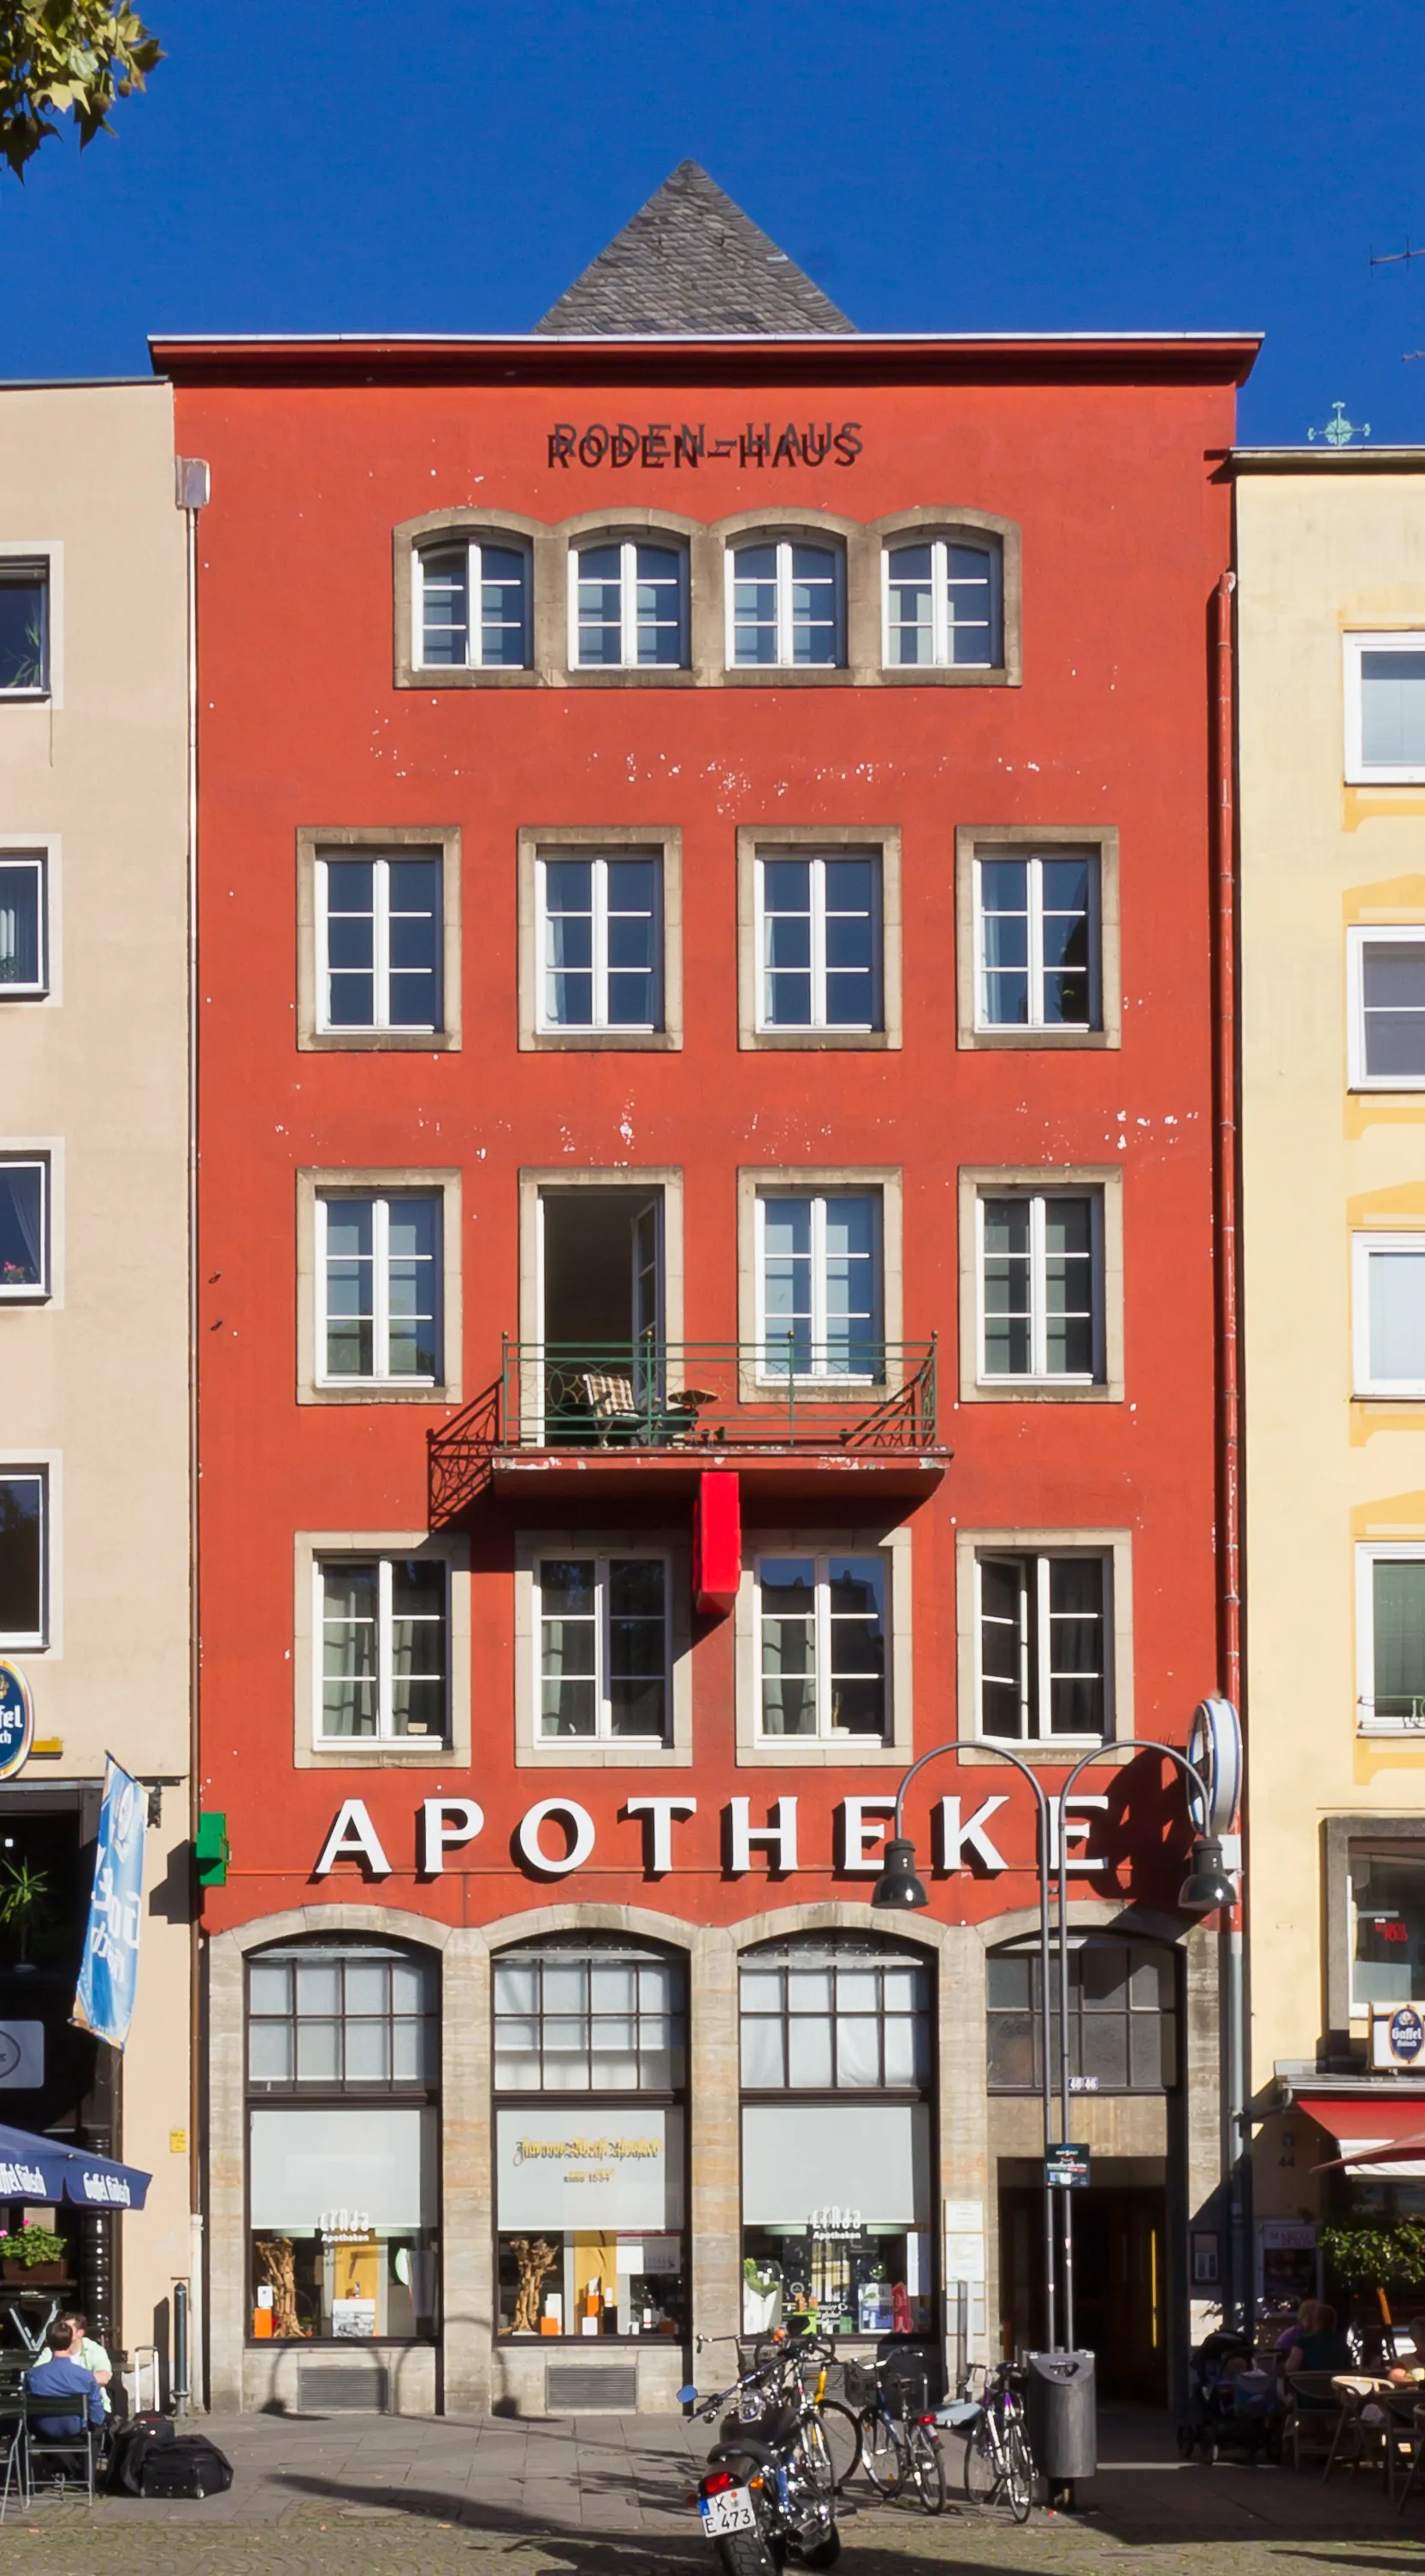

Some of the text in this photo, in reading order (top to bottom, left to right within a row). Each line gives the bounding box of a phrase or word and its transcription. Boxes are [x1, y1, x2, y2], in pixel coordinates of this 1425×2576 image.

[553, 422, 864, 458] RODEN-HAUS
[316, 1796, 1109, 1874] APOTHEKE
[1392, 2027, 1422, 2040] Gaffel
[83, 2171, 110, 2202] Gaffel
[321, 2233, 370, 2243] Apotheken
[813, 2231, 861, 2241] Apotheken
[715, 2496, 727, 2513] K
[705, 2508, 751, 2534] E 473
